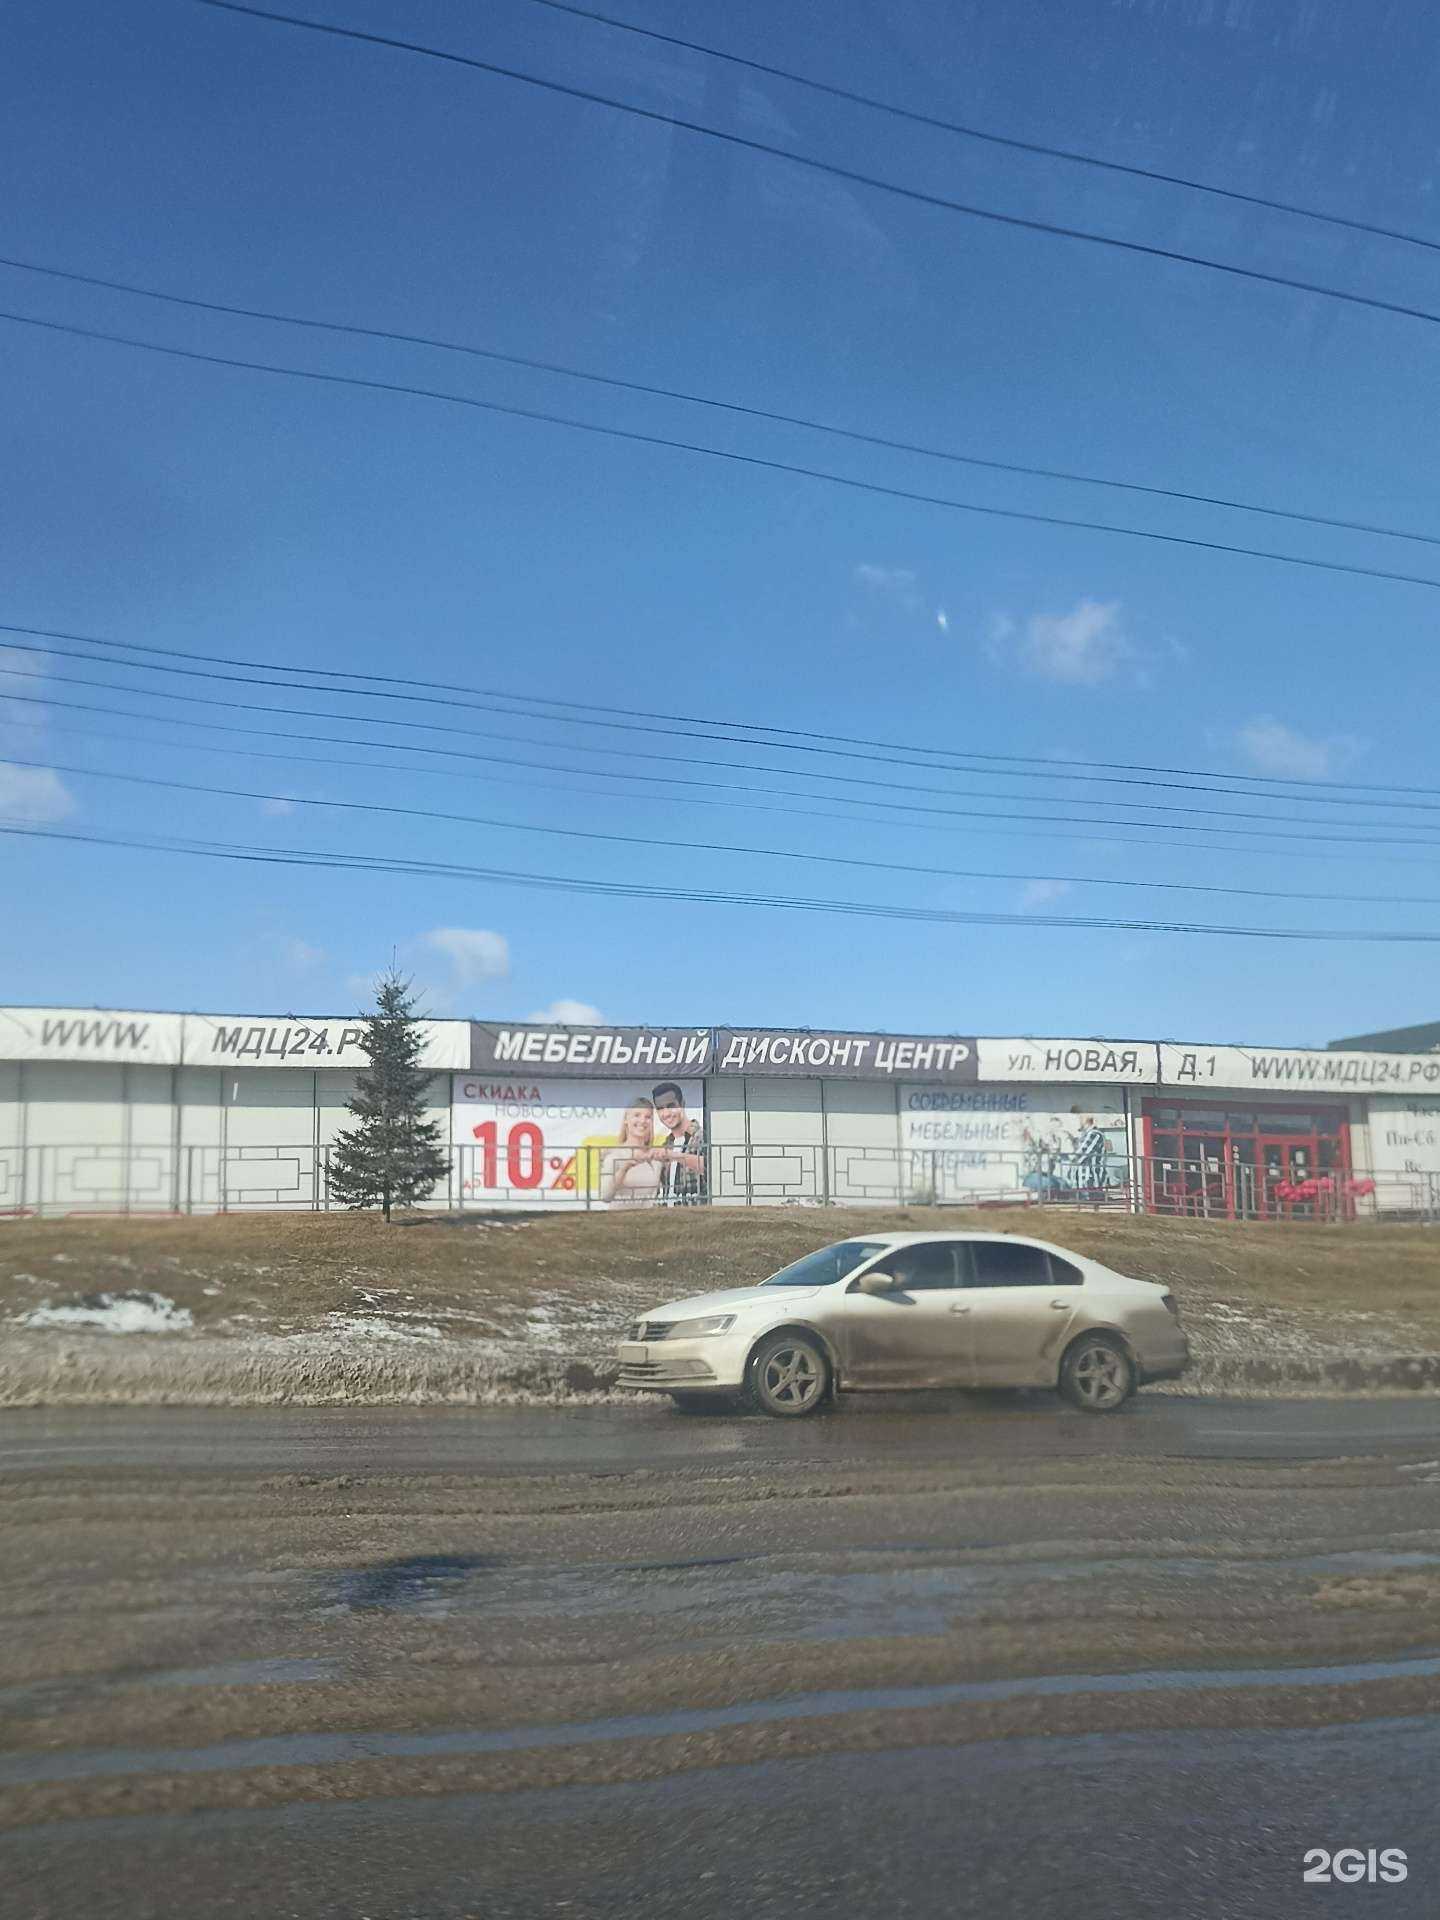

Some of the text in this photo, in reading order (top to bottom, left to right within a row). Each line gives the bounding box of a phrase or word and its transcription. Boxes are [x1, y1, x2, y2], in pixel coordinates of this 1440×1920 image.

[493, 1029, 970, 1074] МЕБЕЛЬНЫЙ ДИСКОНТ ЦЕНТР
[1044, 1049, 1143, 1077] НОВАЯ,
[463, 1083, 542, 1101] СКИДКА
